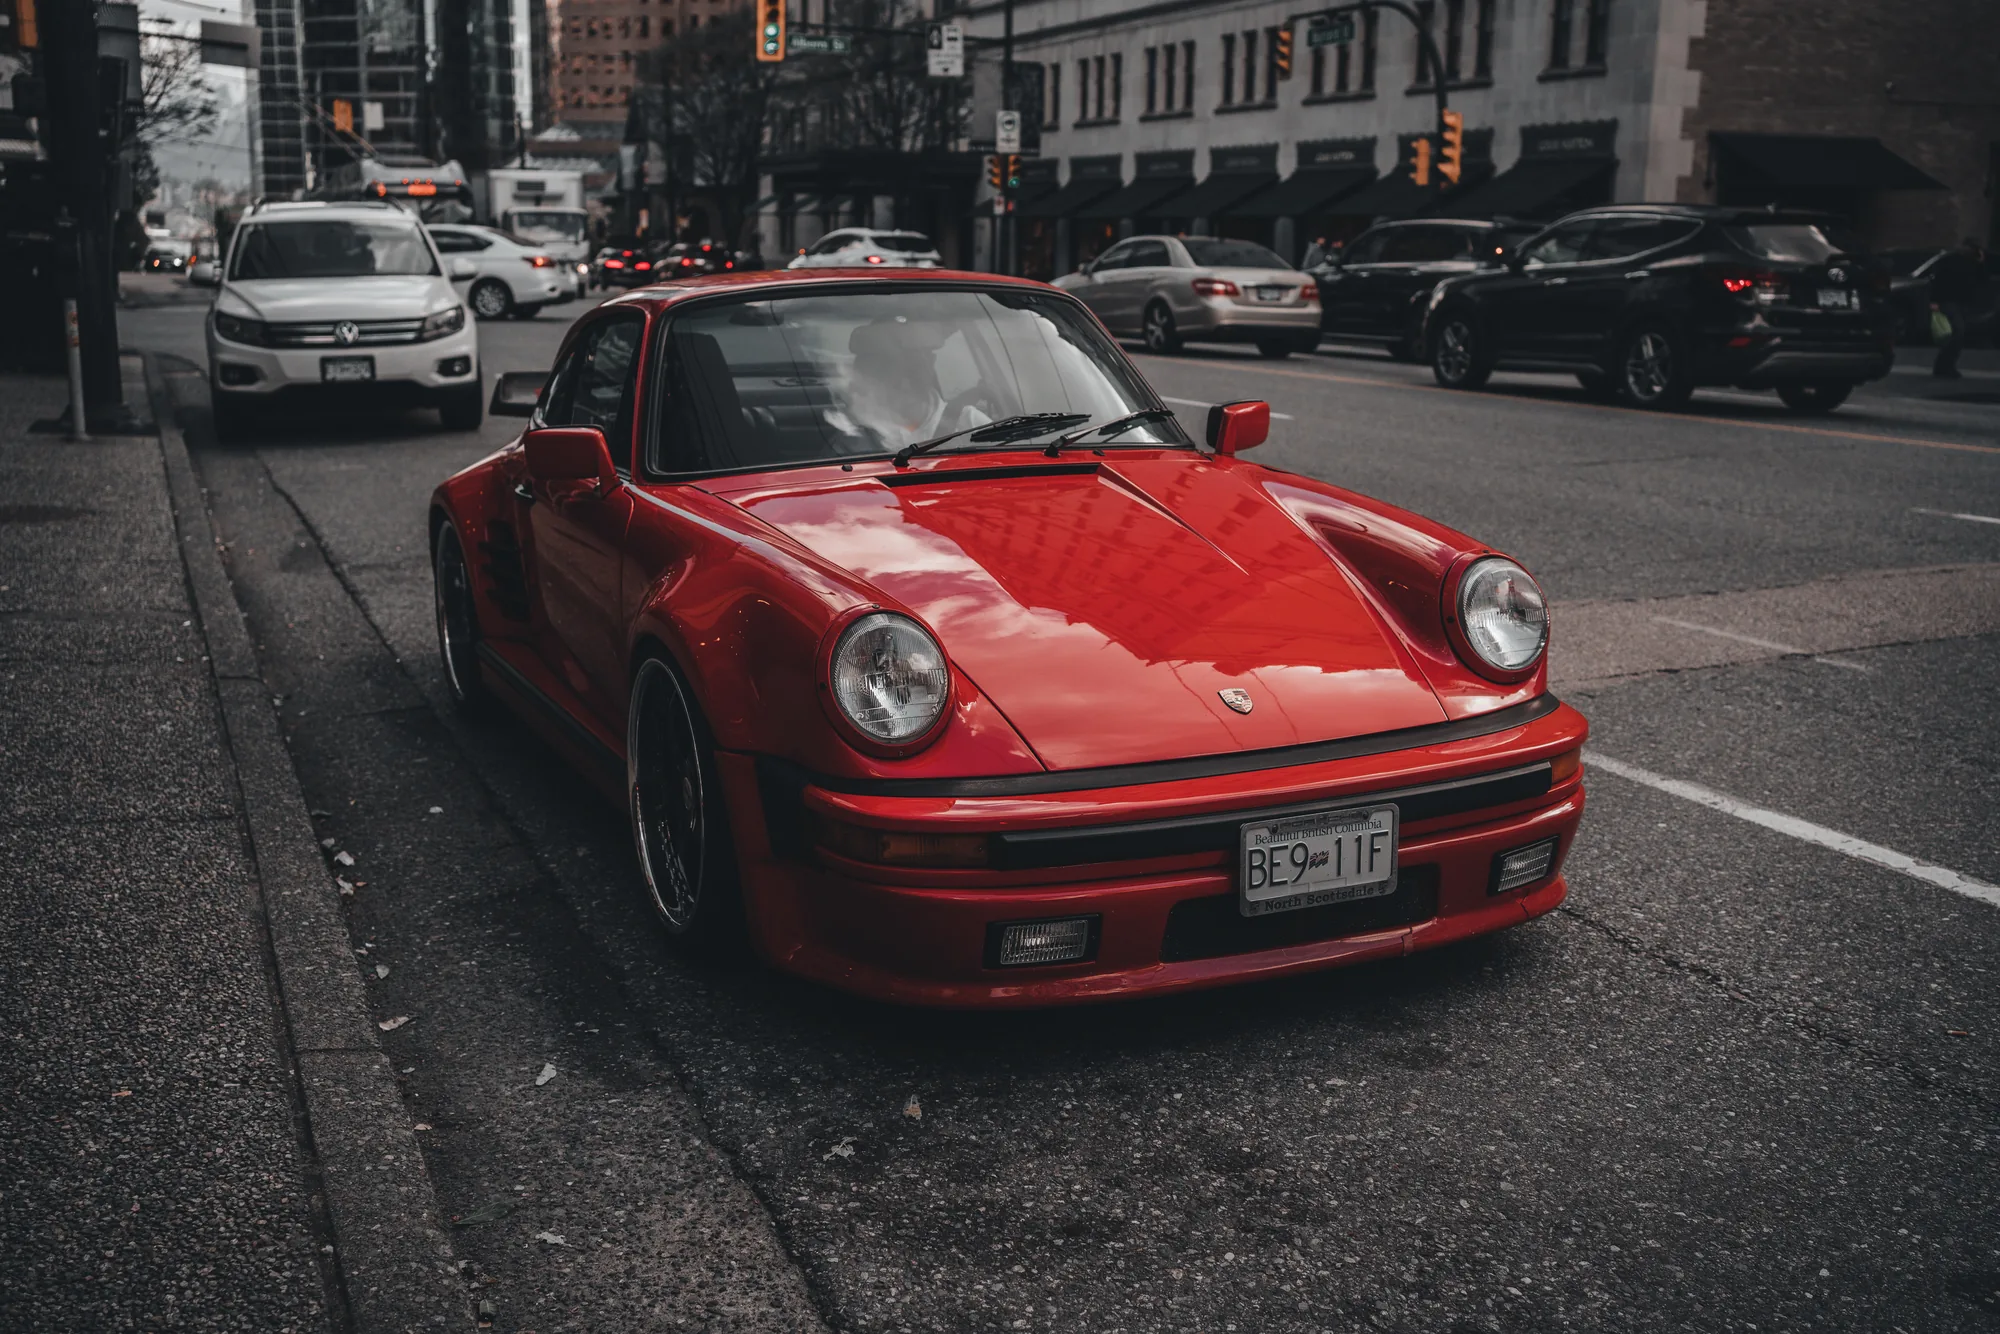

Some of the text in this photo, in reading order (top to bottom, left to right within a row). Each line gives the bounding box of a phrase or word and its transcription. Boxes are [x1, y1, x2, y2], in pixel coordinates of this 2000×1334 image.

[1255, 819, 1382, 845] Beautiful British Columbia
[1247, 830, 1389, 890] BE9 11F
[1265, 886, 1375, 912] North Scottsdale
